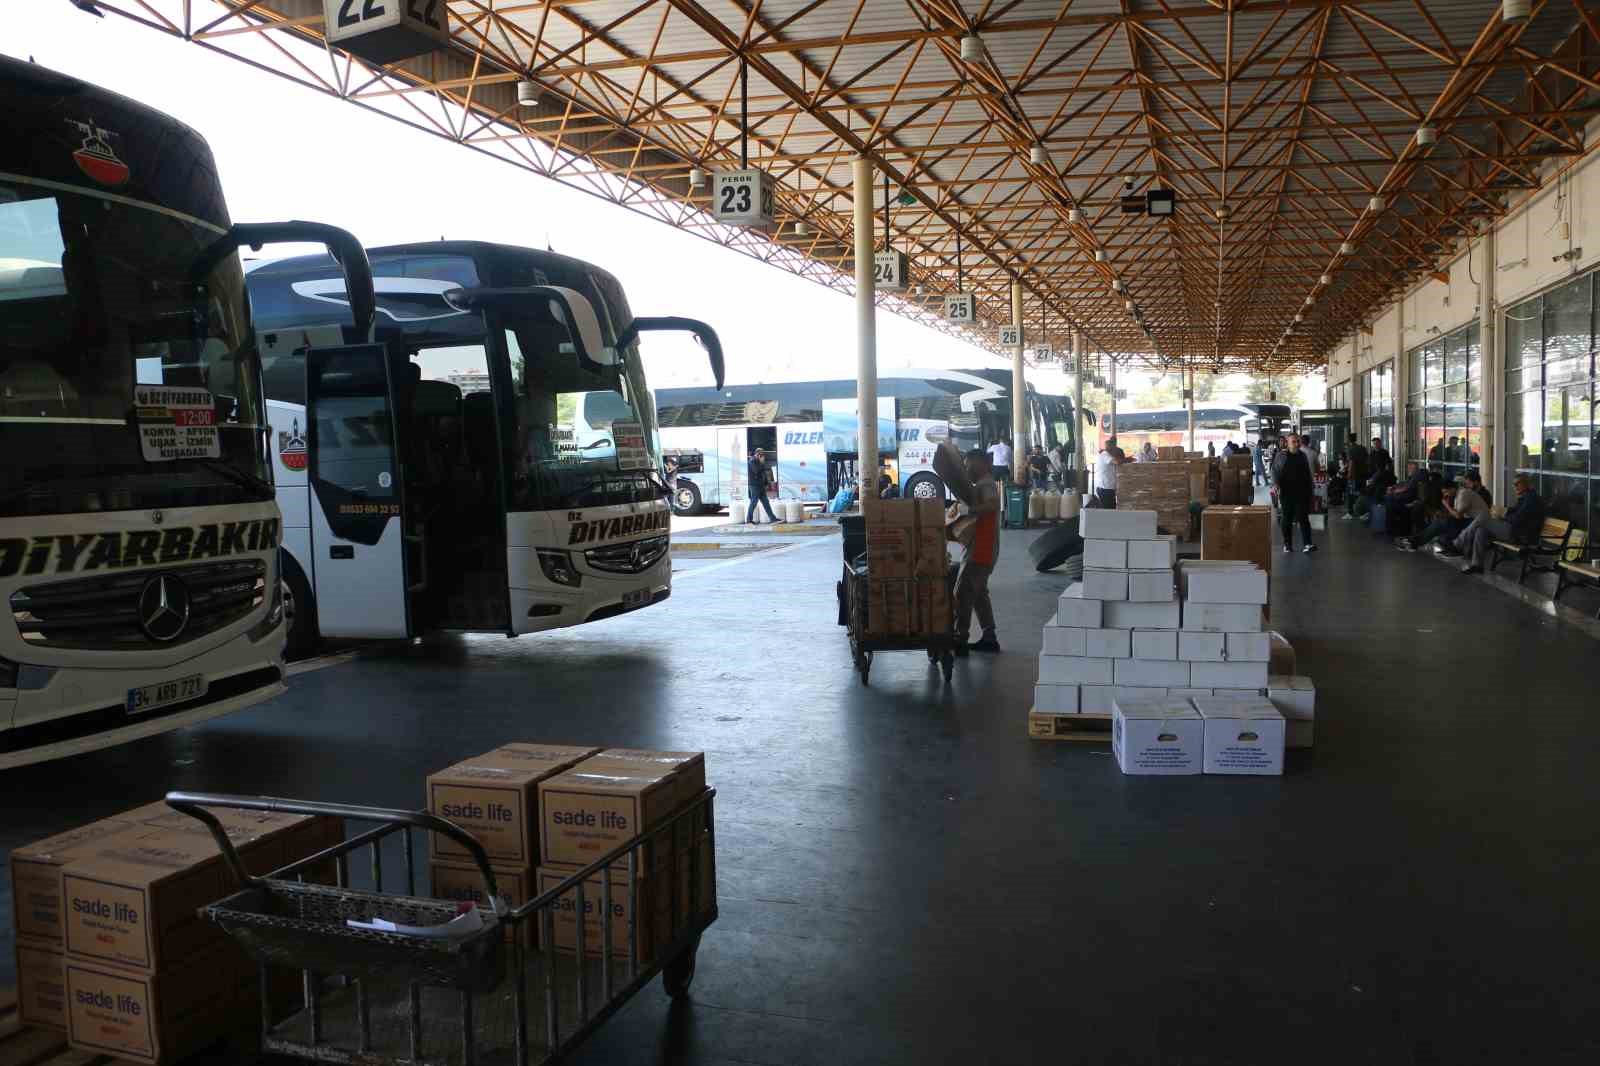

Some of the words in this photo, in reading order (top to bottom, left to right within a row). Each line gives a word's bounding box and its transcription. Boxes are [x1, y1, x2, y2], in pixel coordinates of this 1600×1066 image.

[721, 175, 752, 183] PERON
[720, 185, 751, 214] 23
[874, 263, 894, 282] 24
[950, 303, 967, 318] 25
[1002, 331, 1017, 344] 26
[1037, 349, 1049, 360] 27
[183, 410, 210, 425] 12:00
[135, 689, 150, 706] 34
[441, 800, 483, 819] sade
[487, 803, 513, 822] life
[552, 809, 596, 827] sade
[600, 810, 627, 830] life
[72, 896, 111, 919] sade
[113, 902, 139, 924] life
[551, 895, 593, 913] sae
[598, 897, 625, 917] lfe
[75, 988, 113, 1010] sade
[117, 994, 142, 1016] life
